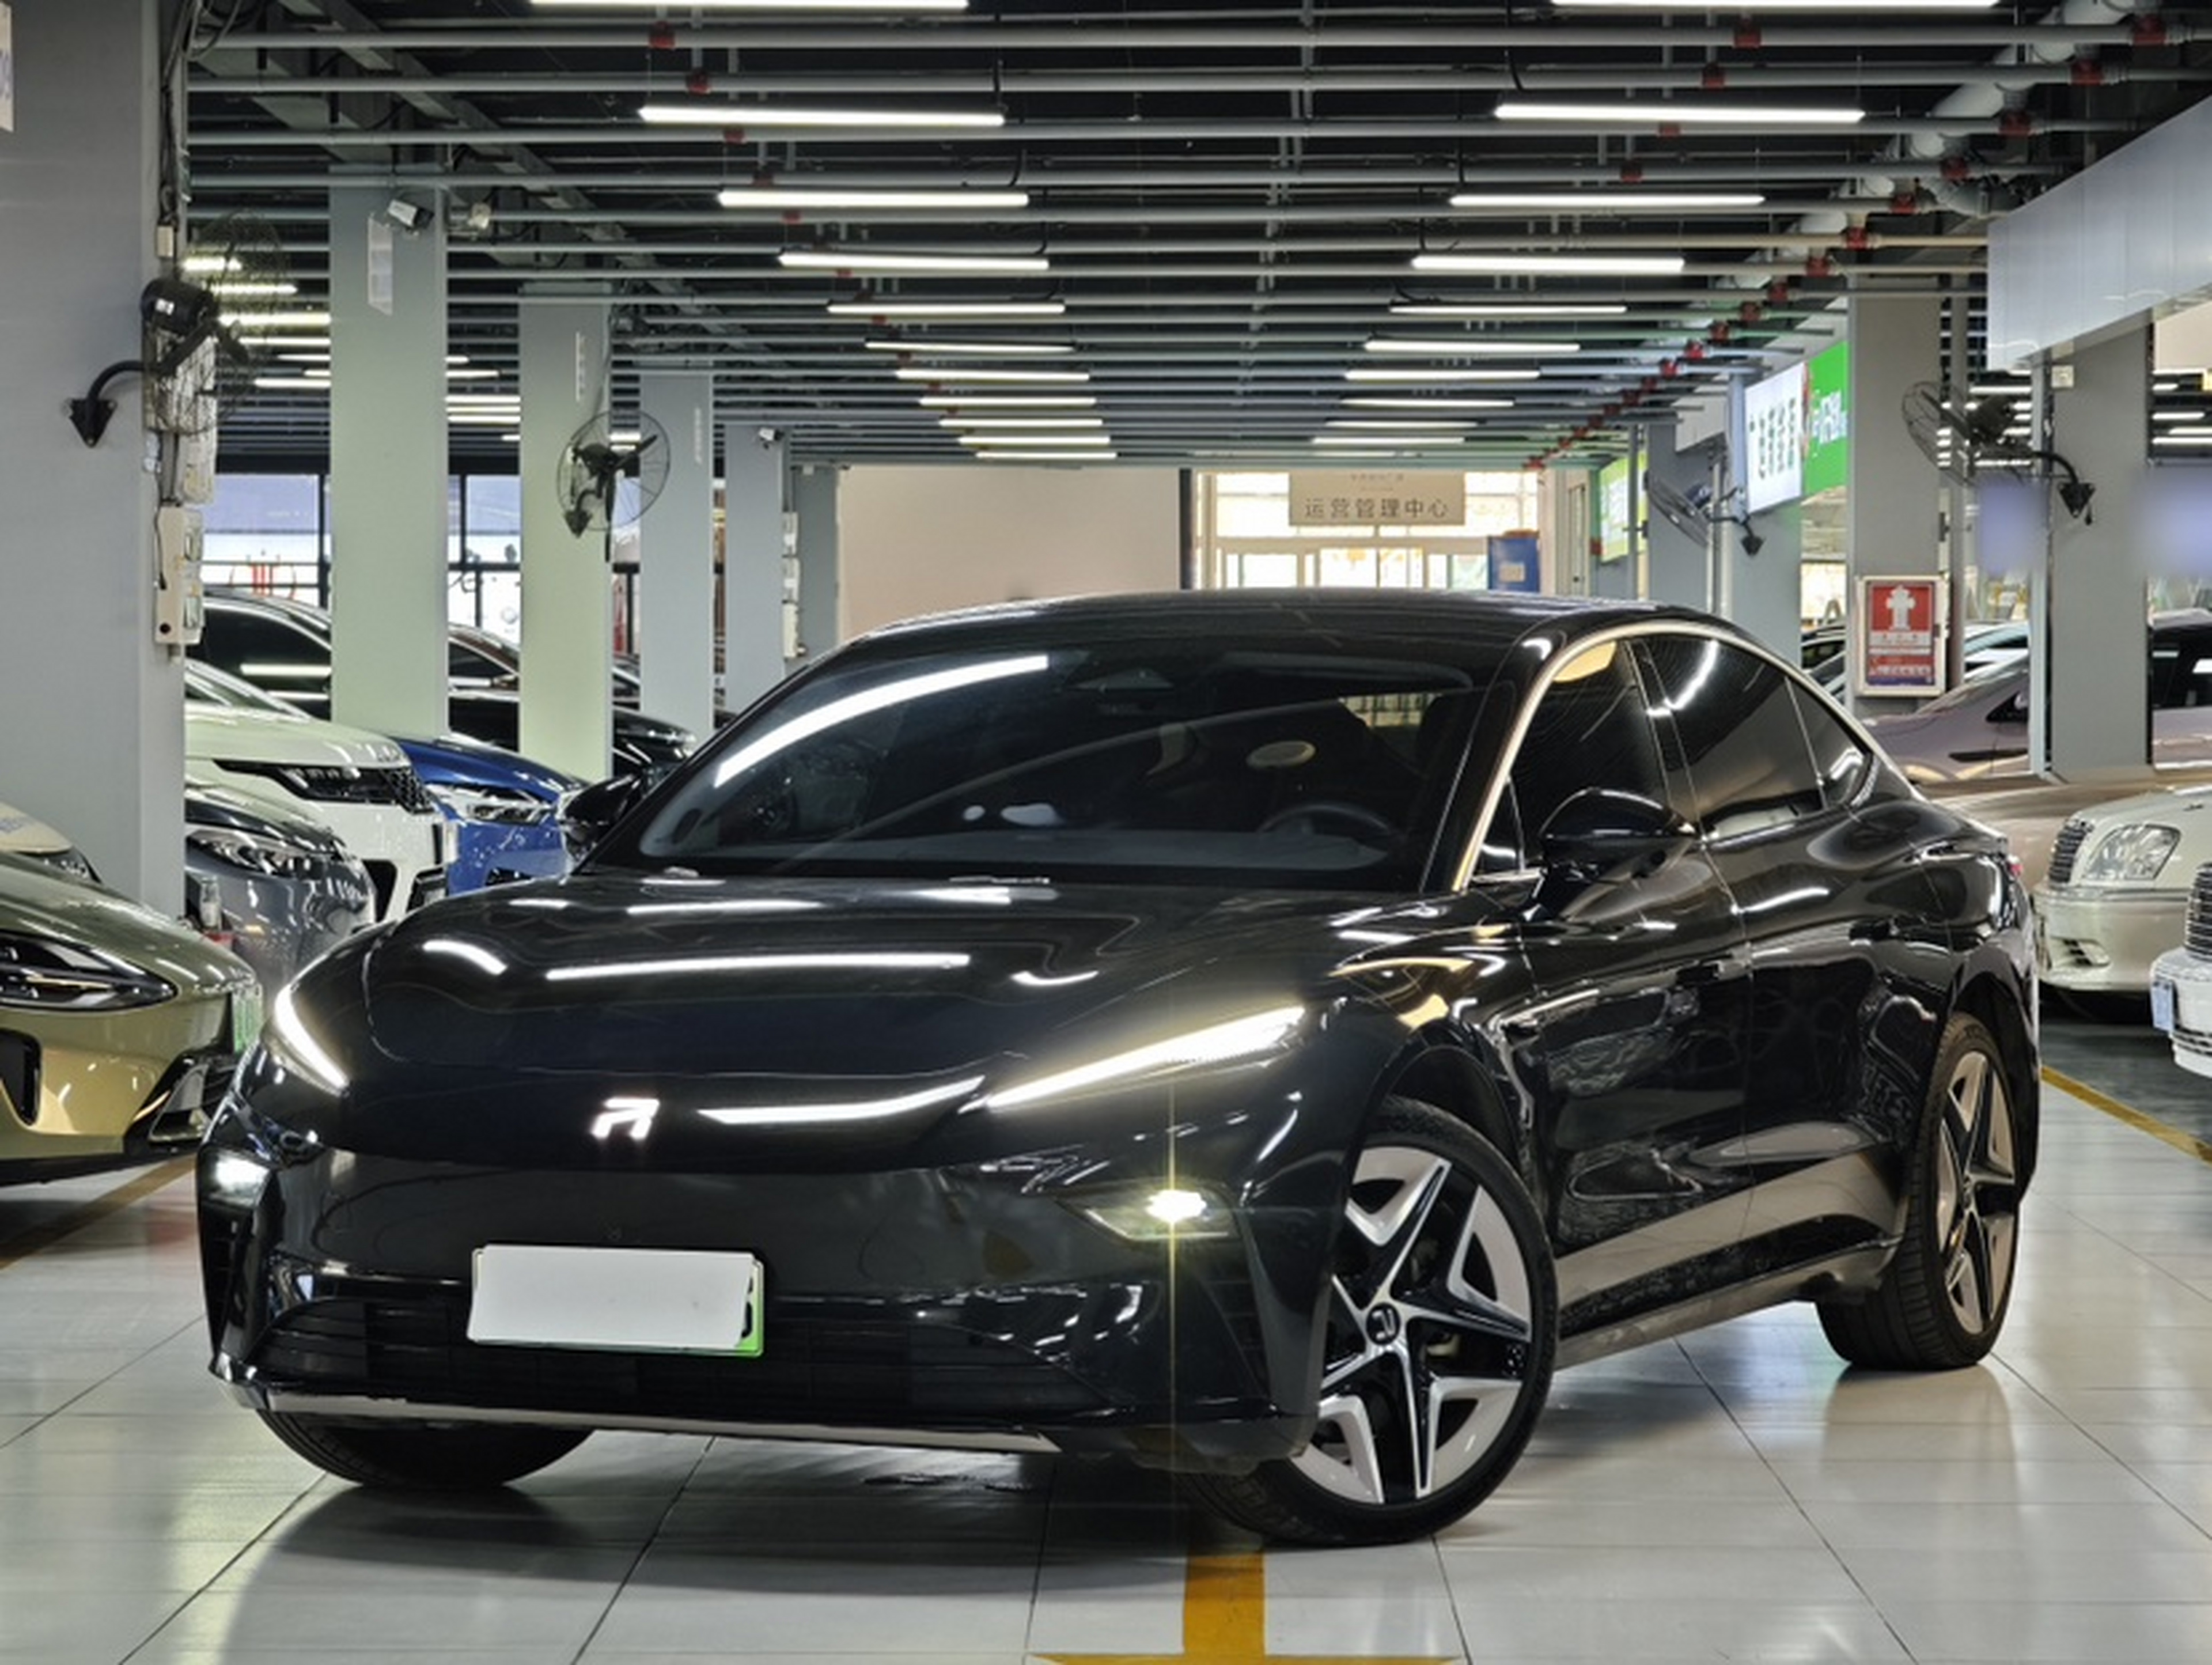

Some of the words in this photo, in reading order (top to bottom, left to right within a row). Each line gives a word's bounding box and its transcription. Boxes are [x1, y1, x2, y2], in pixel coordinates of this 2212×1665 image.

[1305, 498, 1448, 518] 运营管理中心
